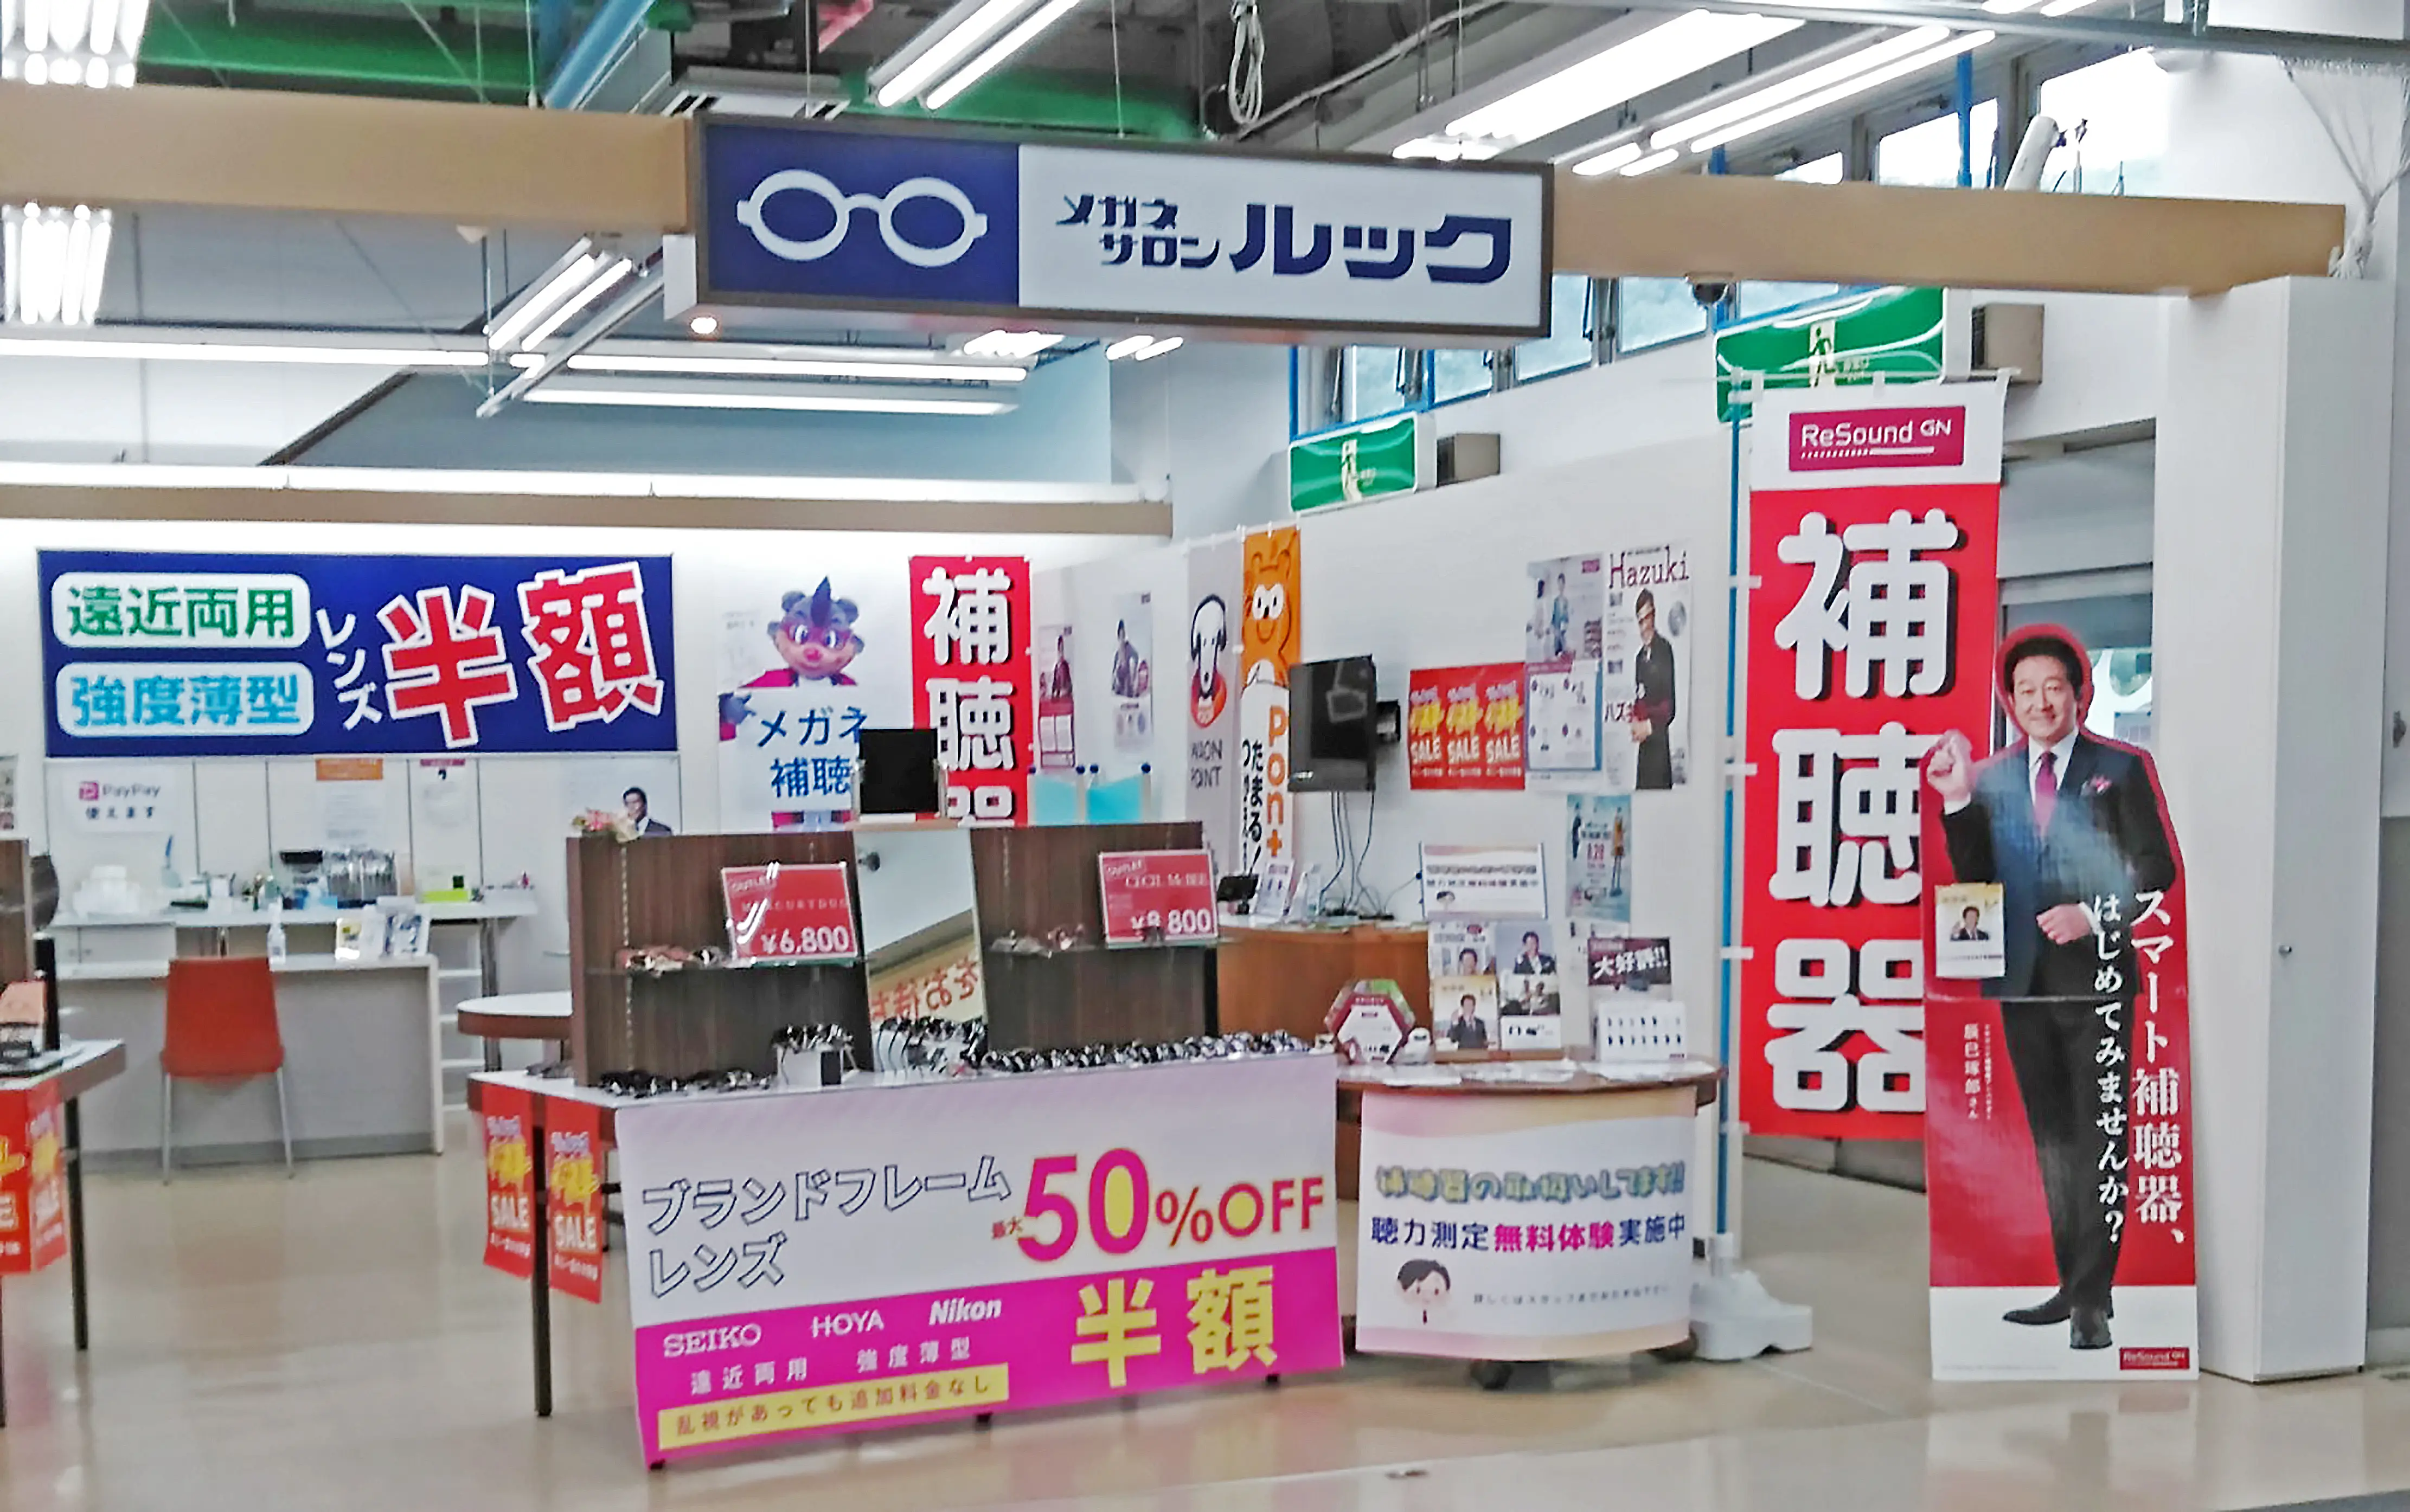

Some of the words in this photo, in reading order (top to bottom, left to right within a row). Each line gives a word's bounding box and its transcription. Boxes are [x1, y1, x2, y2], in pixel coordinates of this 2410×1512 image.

[1056, 193, 1180, 229] メガネ
[1100, 233, 1221, 269] サロン
[1229, 203, 1512, 284] ルック
[1801, 420, 1913, 447] ReSound
[1920, 419, 1952, 437] GN
[1609, 544, 1690, 589] Hazuki
[67, 587, 295, 639] 遠近両用
[316, 608, 382, 731] レンズ
[376, 561, 664, 749] 半額
[71, 674, 300, 726] 強度薄型
[757, 706, 868, 748] メガネ
[1486, 734, 1521, 764] SALE
[1411, 735, 1442, 765] SALE
[1447, 735, 1480, 765] SALE
[102, 783, 162, 799] PayPay
[1765, 508, 1960, 1114] 補聴器
[760, 925, 849, 955] ¥6,800
[490, 1194, 530, 1229] SALE
[643, 1155, 1012, 1236] ブランドフレーム
[554, 1214, 597, 1250] SALE
[649, 1230, 788, 1299] レンズ
[663, 1323, 762, 1359] SEIKO
[810, 1310, 885, 1340] HOYA
[928, 1298, 1002, 1327] Nikon
[1071, 1265, 1278, 1388] 半額
[691, 1357, 807, 1395] 遠近両用
[856, 1336, 971, 1374] 強度薄型
